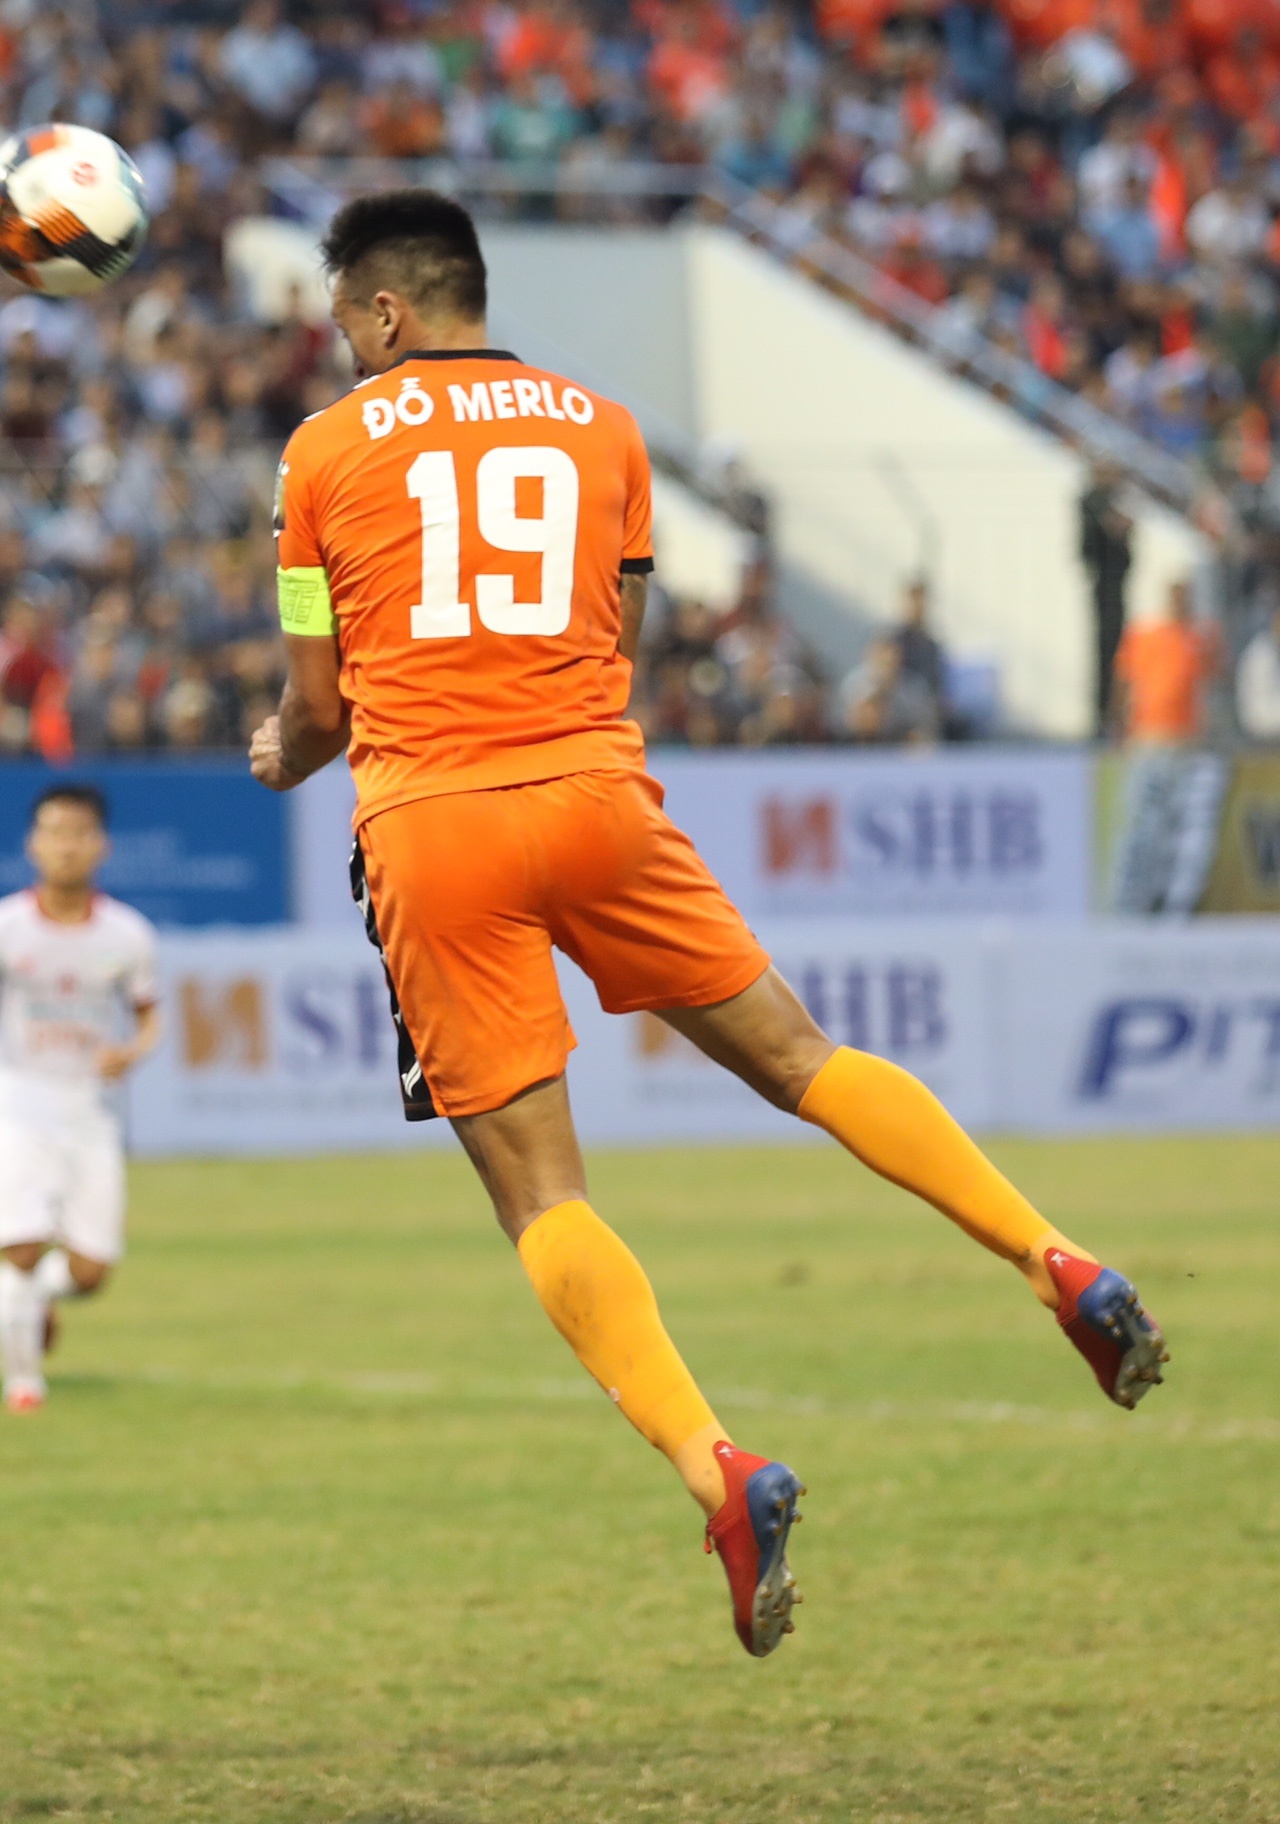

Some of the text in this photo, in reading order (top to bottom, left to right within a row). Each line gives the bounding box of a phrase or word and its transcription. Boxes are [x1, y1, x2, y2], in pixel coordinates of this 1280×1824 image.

[362, 377, 594, 440] ĐỖ MERLO
[405, 446, 579, 640] 19
[774, 956, 950, 1053] HB
